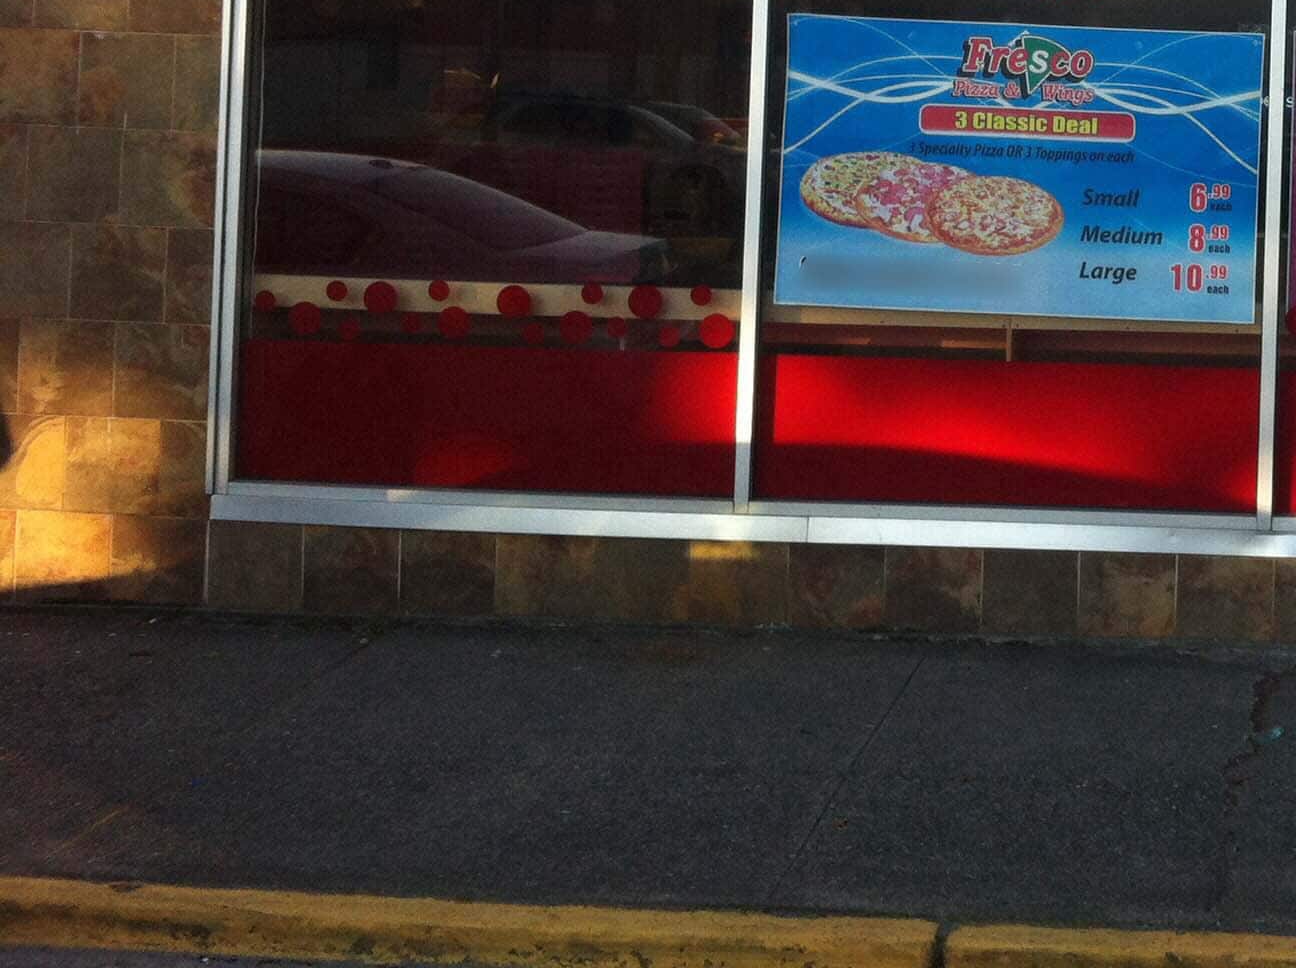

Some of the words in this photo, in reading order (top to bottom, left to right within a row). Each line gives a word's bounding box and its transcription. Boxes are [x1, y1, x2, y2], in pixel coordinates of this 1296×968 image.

[961, 36, 1095, 78] Fresco
[953, 80, 1001, 98] Pizza
[1004, 81, 1022, 99] &
[1042, 82, 1096, 105] Wings
[954, 110, 968, 129] 3
[972, 111, 1048, 132] Classic
[1052, 116, 1099, 135] Deal
[917, 141, 972, 157] Specialty
[974, 144, 1003, 158] Pizza
[1006, 145, 1024, 158] OR
[1035, 146, 1088, 163] Toppings
[1106, 151, 1135, 163] each
[1082, 187, 1140, 208] Small
[1189, 183, 1232, 213] 6.99
[1080, 225, 1163, 246] Medium
[1188, 223, 1230, 254] 8.99
[1208, 244, 1231, 254] each
[1079, 261, 1137, 285] Large
[1170, 263, 1229, 293] 10.99
[1207, 284, 1230, 295] each
